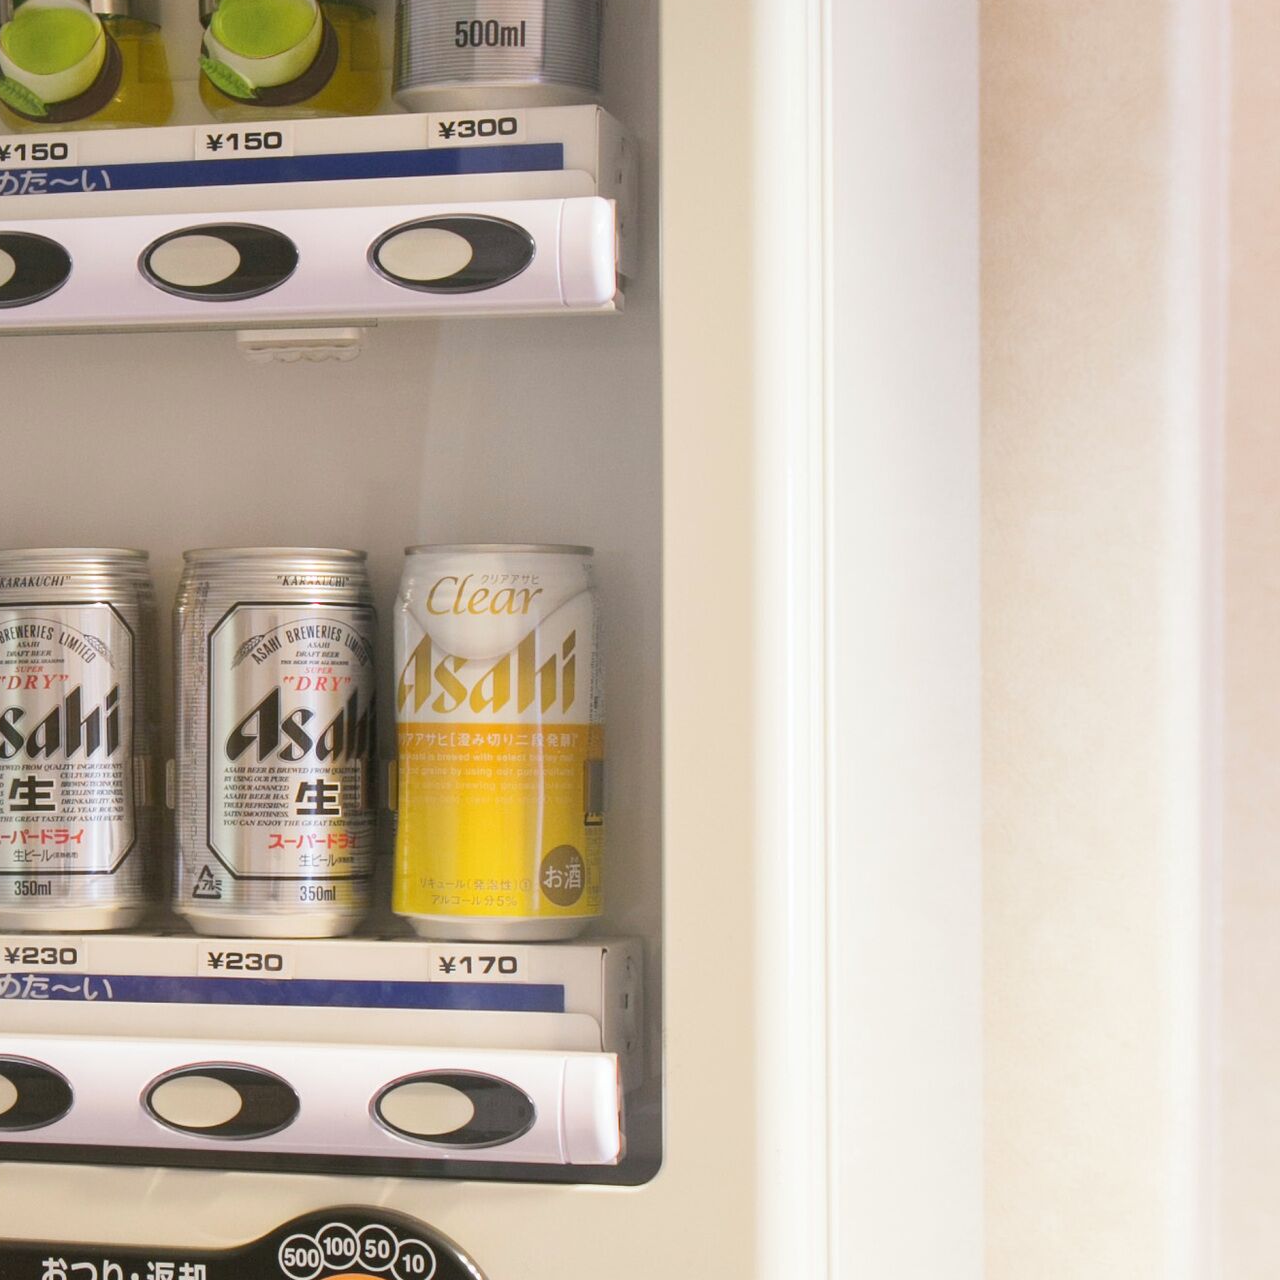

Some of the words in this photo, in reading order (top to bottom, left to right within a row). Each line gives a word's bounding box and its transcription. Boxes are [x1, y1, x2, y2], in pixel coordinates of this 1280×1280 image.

[455, 19, 526, 48] 500ml
[438, 116, 518, 140] ¥300
[206, 131, 283, 152] ¥150
[481, 574, 540, 585] クリアアサヒ
[426, 574, 544, 616] Clear
[59, 631, 97, 664] LIMITED
[251, 636, 283, 665] ASAHI
[285, 624, 342, 645] BREWERIES
[344, 633, 370, 666] LIMITED
[15, 665, 44, 673] SUPER
[397, 629, 577, 715] Asahi
[21, 763, 43, 771] FROM
[43, 763, 74, 772] QUALITY
[9, 775, 56, 812] 生
[295, 779, 341, 816] 生
[15, 815, 40, 823] GREAT
[268, 833, 357, 849] スーパードライ
[13, 849, 54, 863] 生ビール
[299, 854, 338, 868] 生ビール
[202, 879, 223, 892] アルミ
[543, 864, 581, 889] お酒
[14, 880, 52, 896] 350ml
[300, 886, 336, 901] 350ml
[4, 946, 78, 966] ¥230
[207, 952, 284, 972] ¥230
[438, 955, 518, 975] ¥170
[284, 1247, 320, 1269] 500
[322, 1236, 355, 1257] 100
[365, 1238, 391, 1259] 50
[402, 1254, 426, 1275] 10
